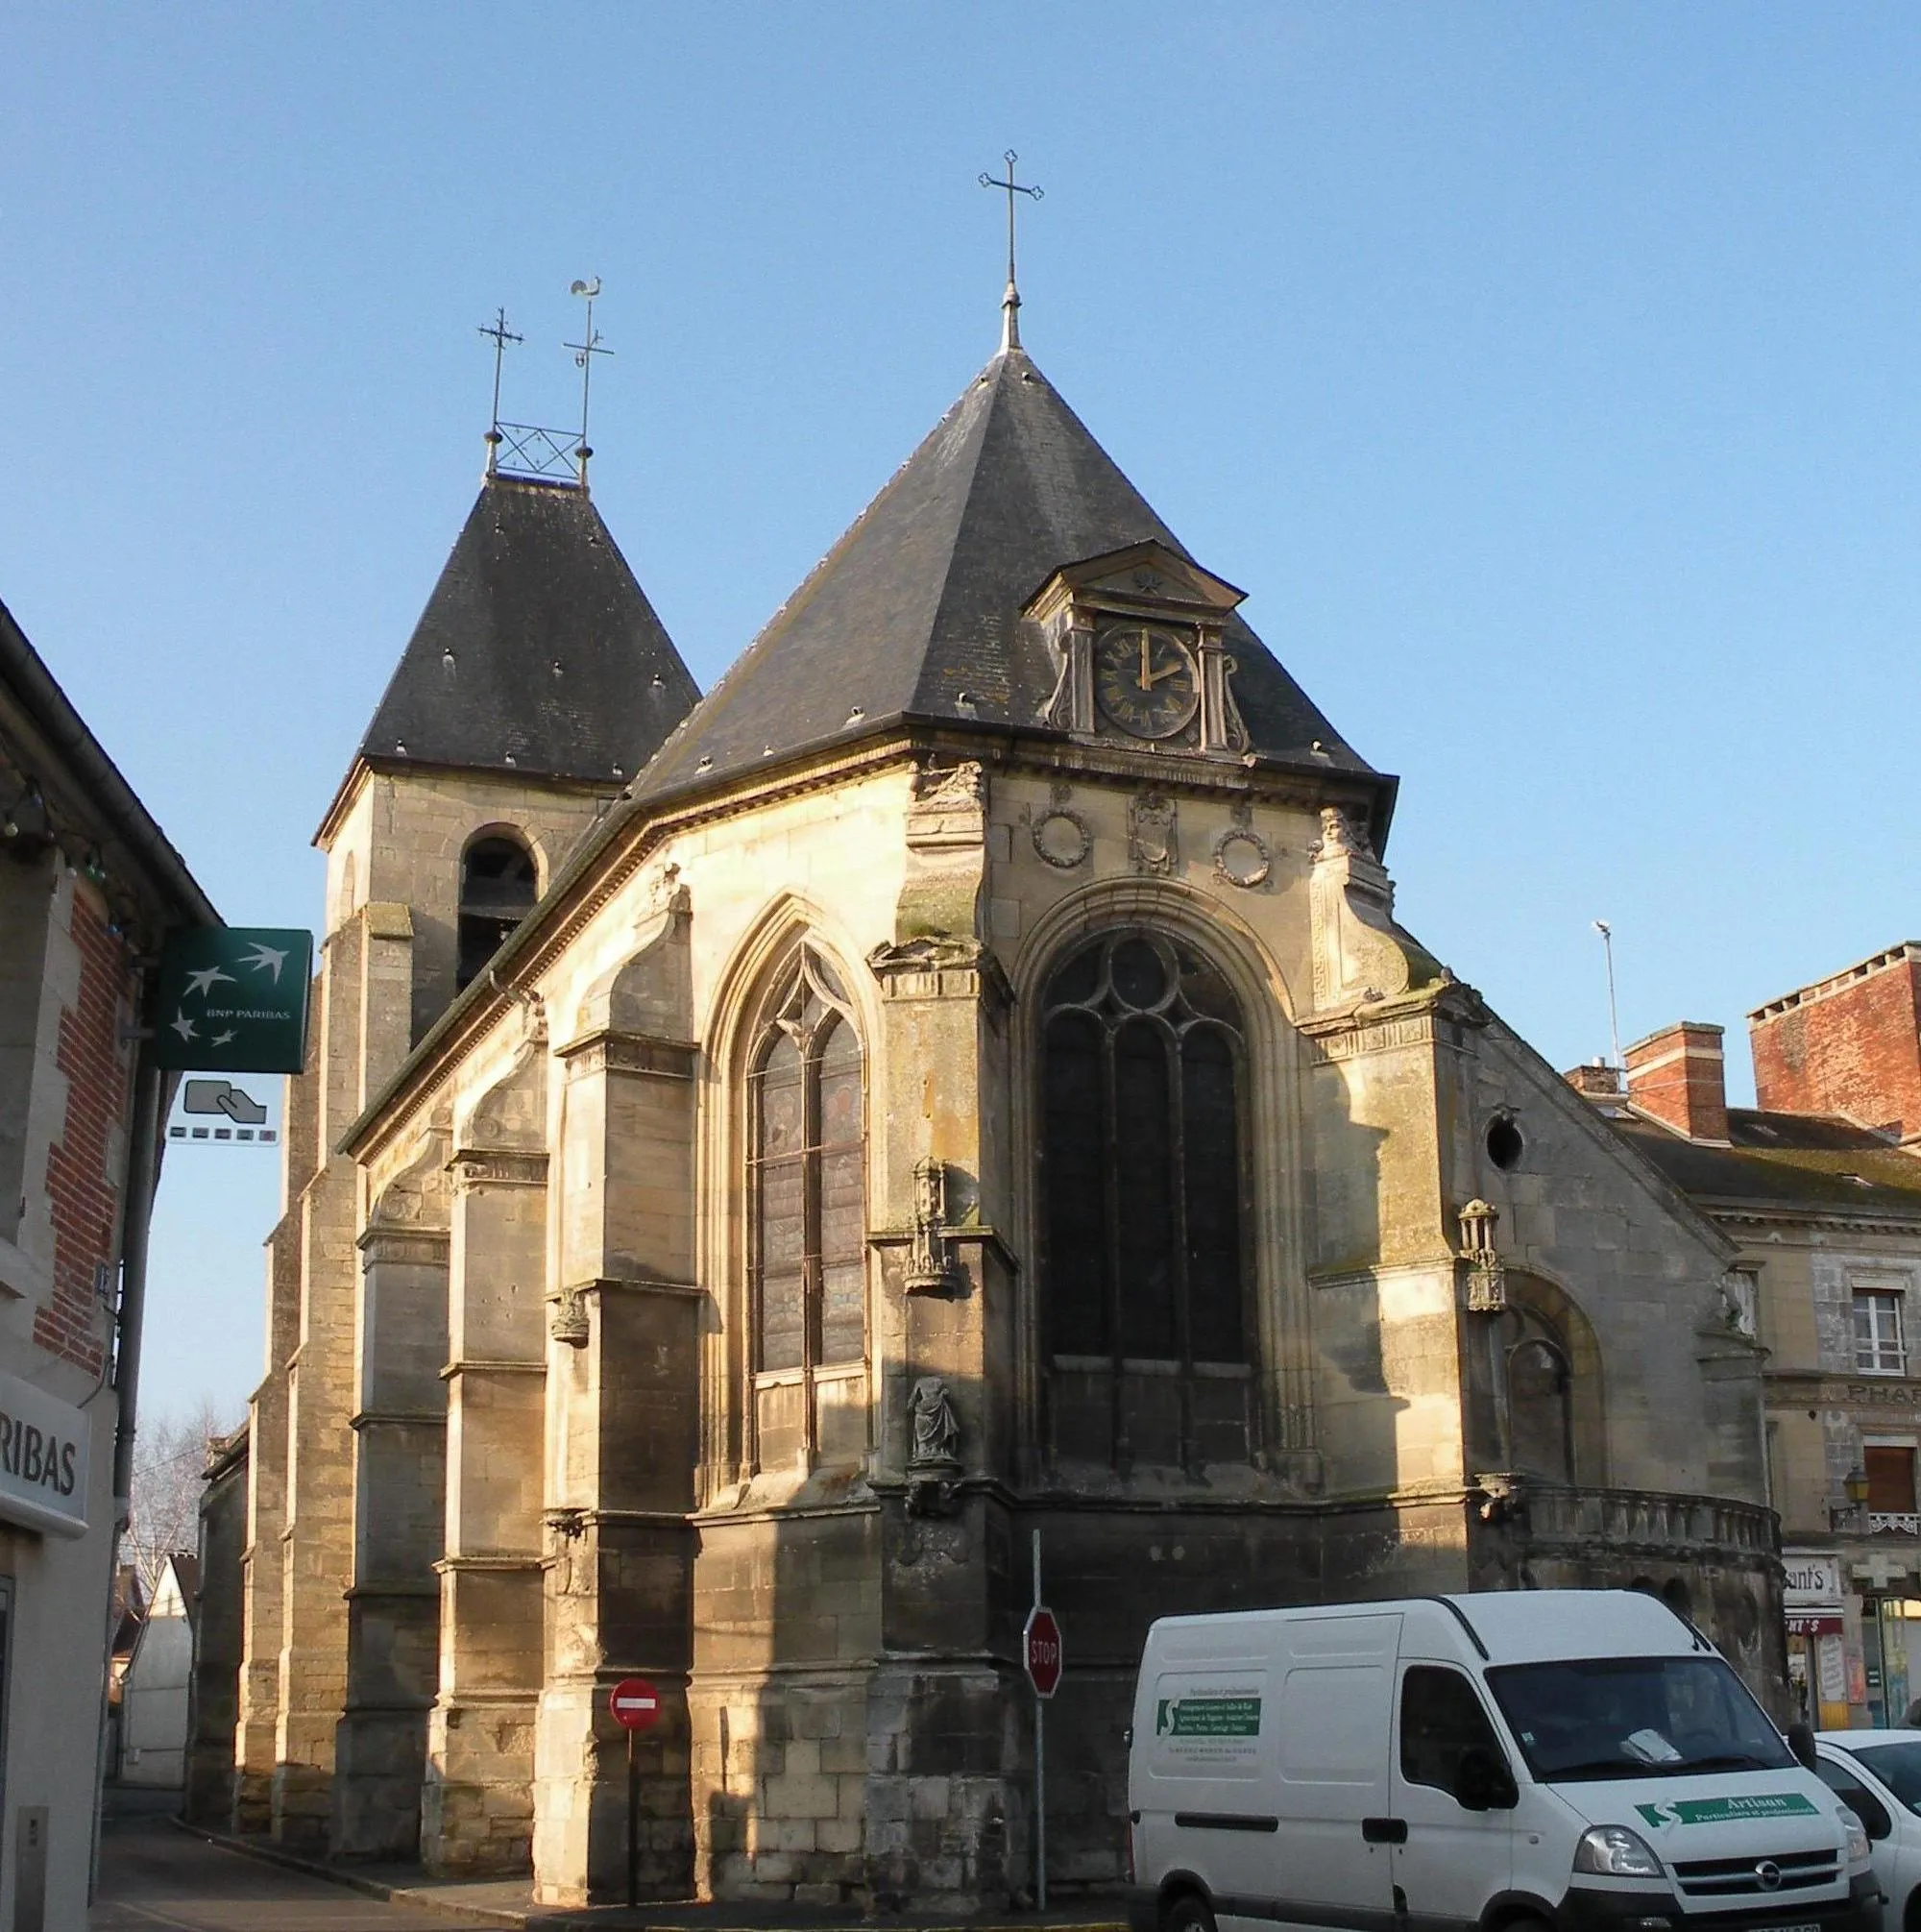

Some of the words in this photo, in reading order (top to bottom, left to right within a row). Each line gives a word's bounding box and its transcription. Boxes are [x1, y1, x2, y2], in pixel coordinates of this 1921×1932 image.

[206, 1009, 233, 1018] BNP
[236, 1010, 291, 1020] PARIBAS
[0, 1411, 76, 1496] RIBAS
[1031, 1640, 1057, 1665] STOP
[1727, 1797, 1787, 1809] Artisan
